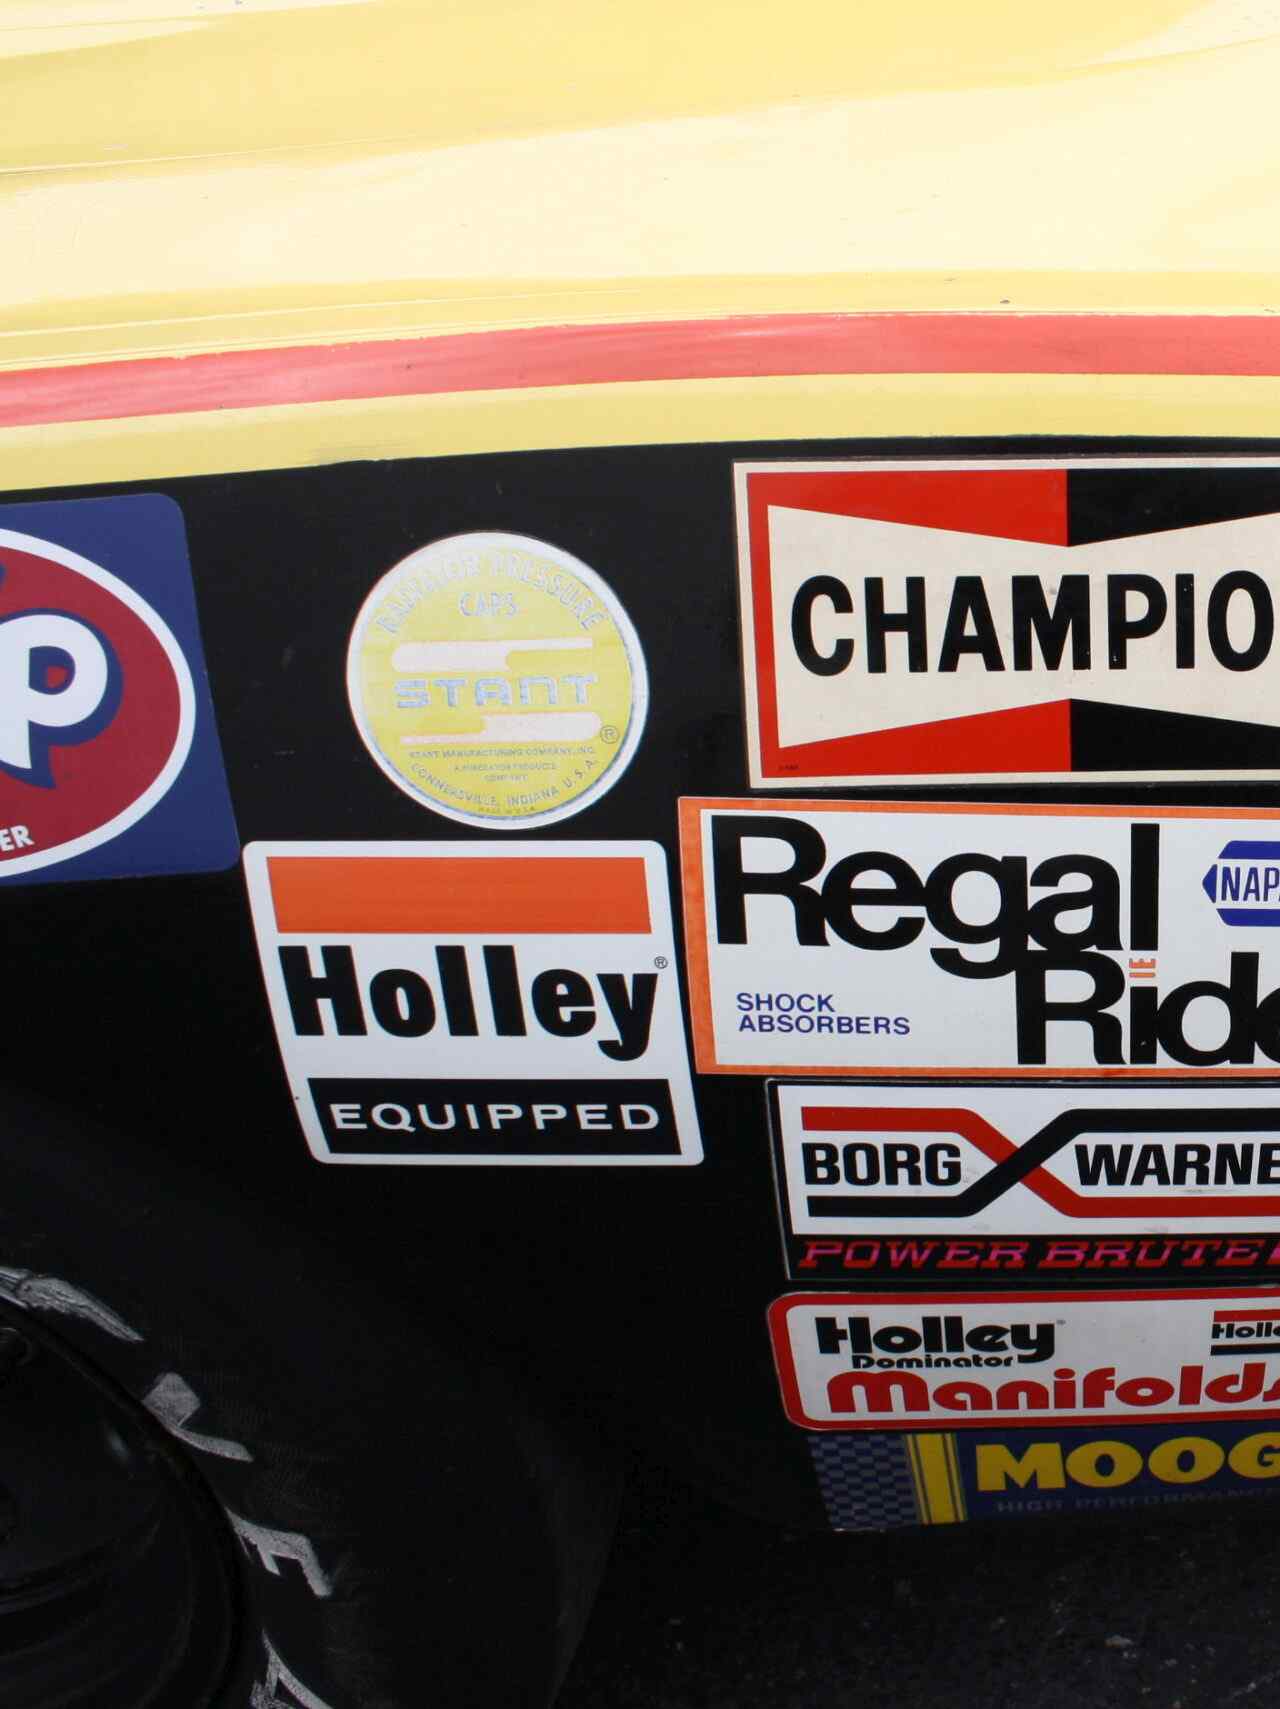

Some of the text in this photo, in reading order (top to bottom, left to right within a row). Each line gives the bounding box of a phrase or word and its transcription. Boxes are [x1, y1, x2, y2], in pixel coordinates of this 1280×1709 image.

[459, 591, 520, 618] CAPS
[394, 673, 598, 709] STANT
[507, 786, 560, 807] INDIANA
[711, 815, 1160, 979] Regal
[278, 945, 658, 1061] Holley
[737, 993, 835, 1013] SHOCK
[738, 1014, 911, 1035] ABSORBERS
[330, 1104, 660, 1132] EQUIPPED
[802, 1142, 961, 1187] BORG
[800, 1239, 1267, 1269] POWER BRUTE
[814, 1316, 1055, 1363] Holley
[852, 1354, 1012, 1369] Dominator
